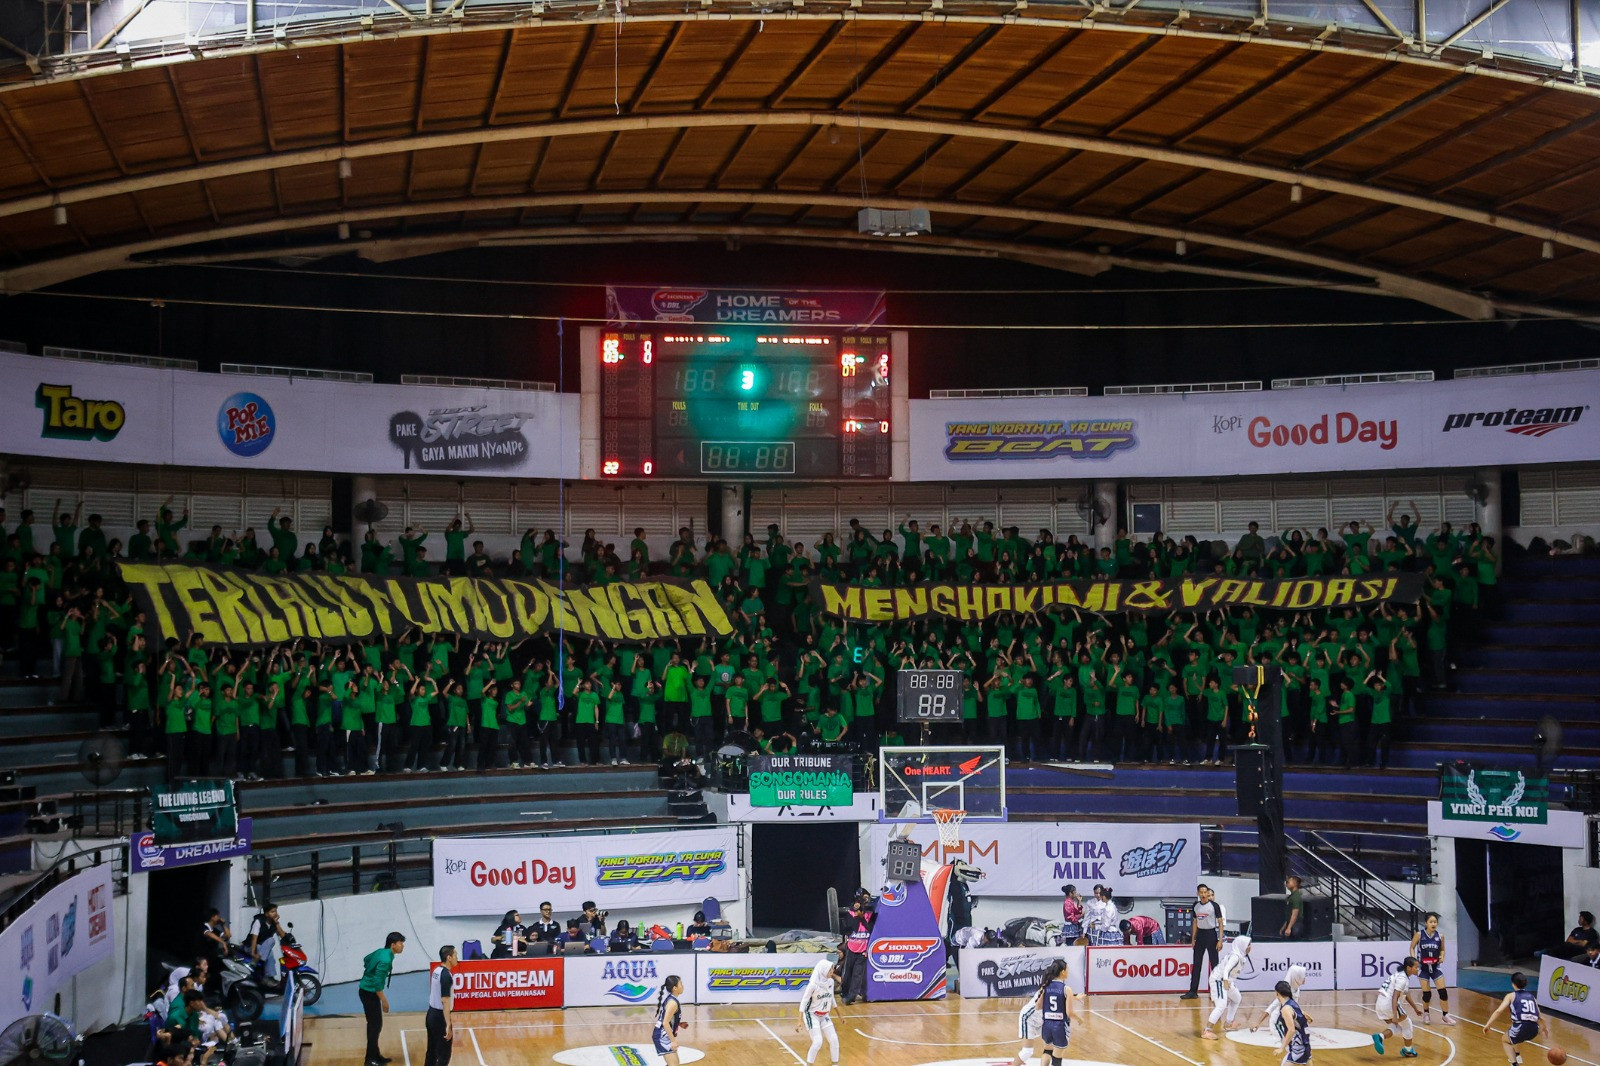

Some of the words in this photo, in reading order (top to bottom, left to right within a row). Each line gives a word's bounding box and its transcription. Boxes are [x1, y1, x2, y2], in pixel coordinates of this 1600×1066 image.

[716, 295, 781, 307] HOME
[716, 309, 841, 321] DREAMERS
[38, 384, 125, 436] Taro
[672, 401, 687, 411] FOULS
[809, 402, 824, 412] FOULS
[227, 402, 258, 430] POP
[1442, 405, 1584, 432] proteam
[235, 416, 270, 444] MIE
[396, 424, 417, 437] PAKE
[420, 412, 534, 443] STREET
[948, 424, 989, 435] YANG
[991, 423, 1046, 435] WORTH
[1069, 422, 1088, 433] YA
[1090, 421, 1133, 433] CUMA
[1247, 414, 1329, 449] Good
[1336, 412, 1398, 450] Day
[422, 447, 445, 462] GAYA
[448, 444, 479, 460] MAKIN
[1125, 581, 1174, 609] &
[1180, 578, 1398, 609] VALIDASI
[771, 757, 790, 768] OUR
[793, 757, 832, 768] TRIBUNE
[904, 766, 921, 775] One
[158, 793, 172, 807] THE
[173, 791, 199, 806] LIVING
[199, 789, 226, 803] LEGEND
[777, 789, 796, 800] OUR
[800, 789, 827, 800] RULES
[1450, 803, 1486, 816] VINCI
[1488, 804, 1513, 817] PER
[1515, 806, 1539, 818] NOI
[1045, 840, 1113, 859] ULTRA
[597, 857, 626, 867] YANG
[627, 855, 664, 866] WORTH
[680, 853, 693, 862] YA
[695, 851, 723, 861] CUMA
[470, 860, 527, 888] Good
[532, 859, 577, 890] Day
[1053, 861, 1107, 880] MILK
[888, 954, 905, 963] DBL
[601, 960, 658, 982] AQUA
[981, 967, 995, 977] PAKE
[1113, 958, 1162, 979] Good
[495, 969, 554, 988] CREAM
[997, 980, 1013, 990] GAYA
[1013, 977, 1033, 988] MAKIN
[470, 991, 491, 999] PEGAL
[493, 990, 506, 998] DAN
[507, 989, 546, 997] PEMANASAN
[1049, 995, 1058, 1011] 5
[1520, 999, 1536, 1014] 30
